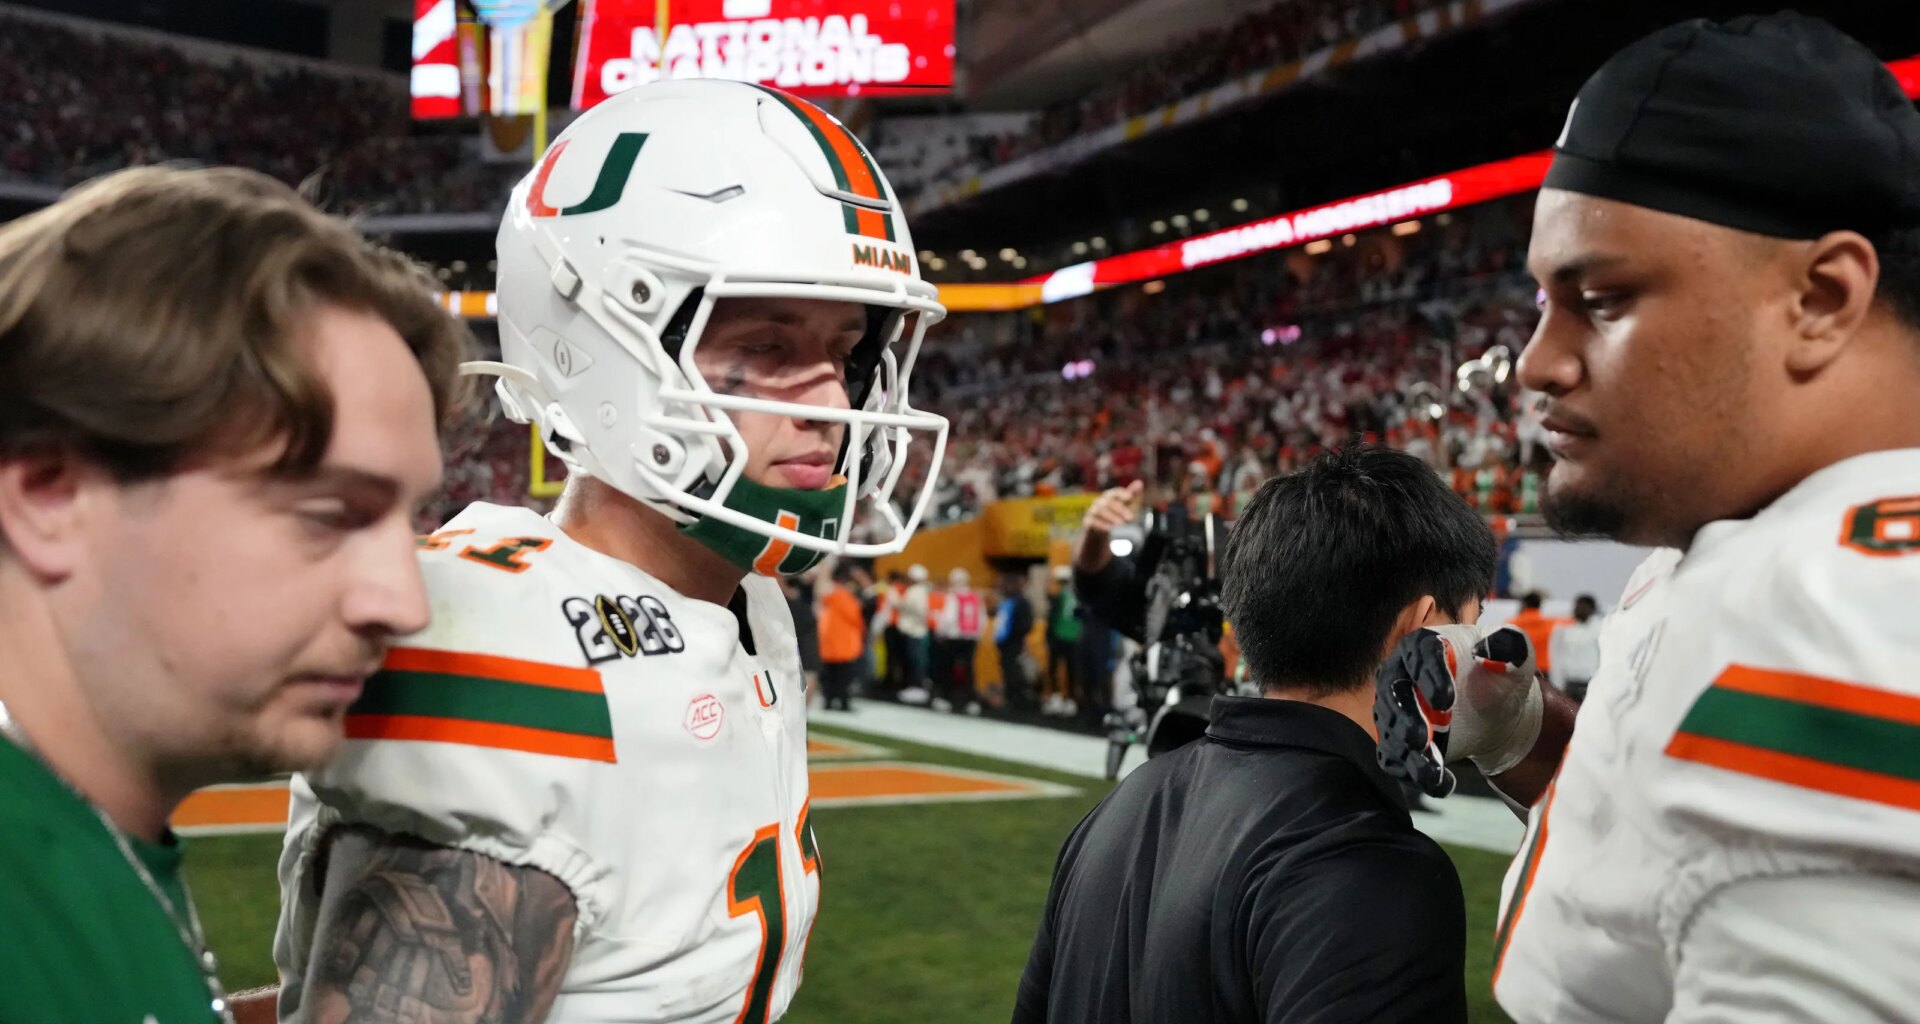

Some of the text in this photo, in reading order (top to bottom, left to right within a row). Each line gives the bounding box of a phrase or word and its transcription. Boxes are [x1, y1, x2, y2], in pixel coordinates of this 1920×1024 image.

[631, 14, 882, 62] NATIONAL
[601, 43, 910, 95] CHAMPIONS
[852, 243, 912, 276] MIAMI
[691, 701, 718, 725] ACC
